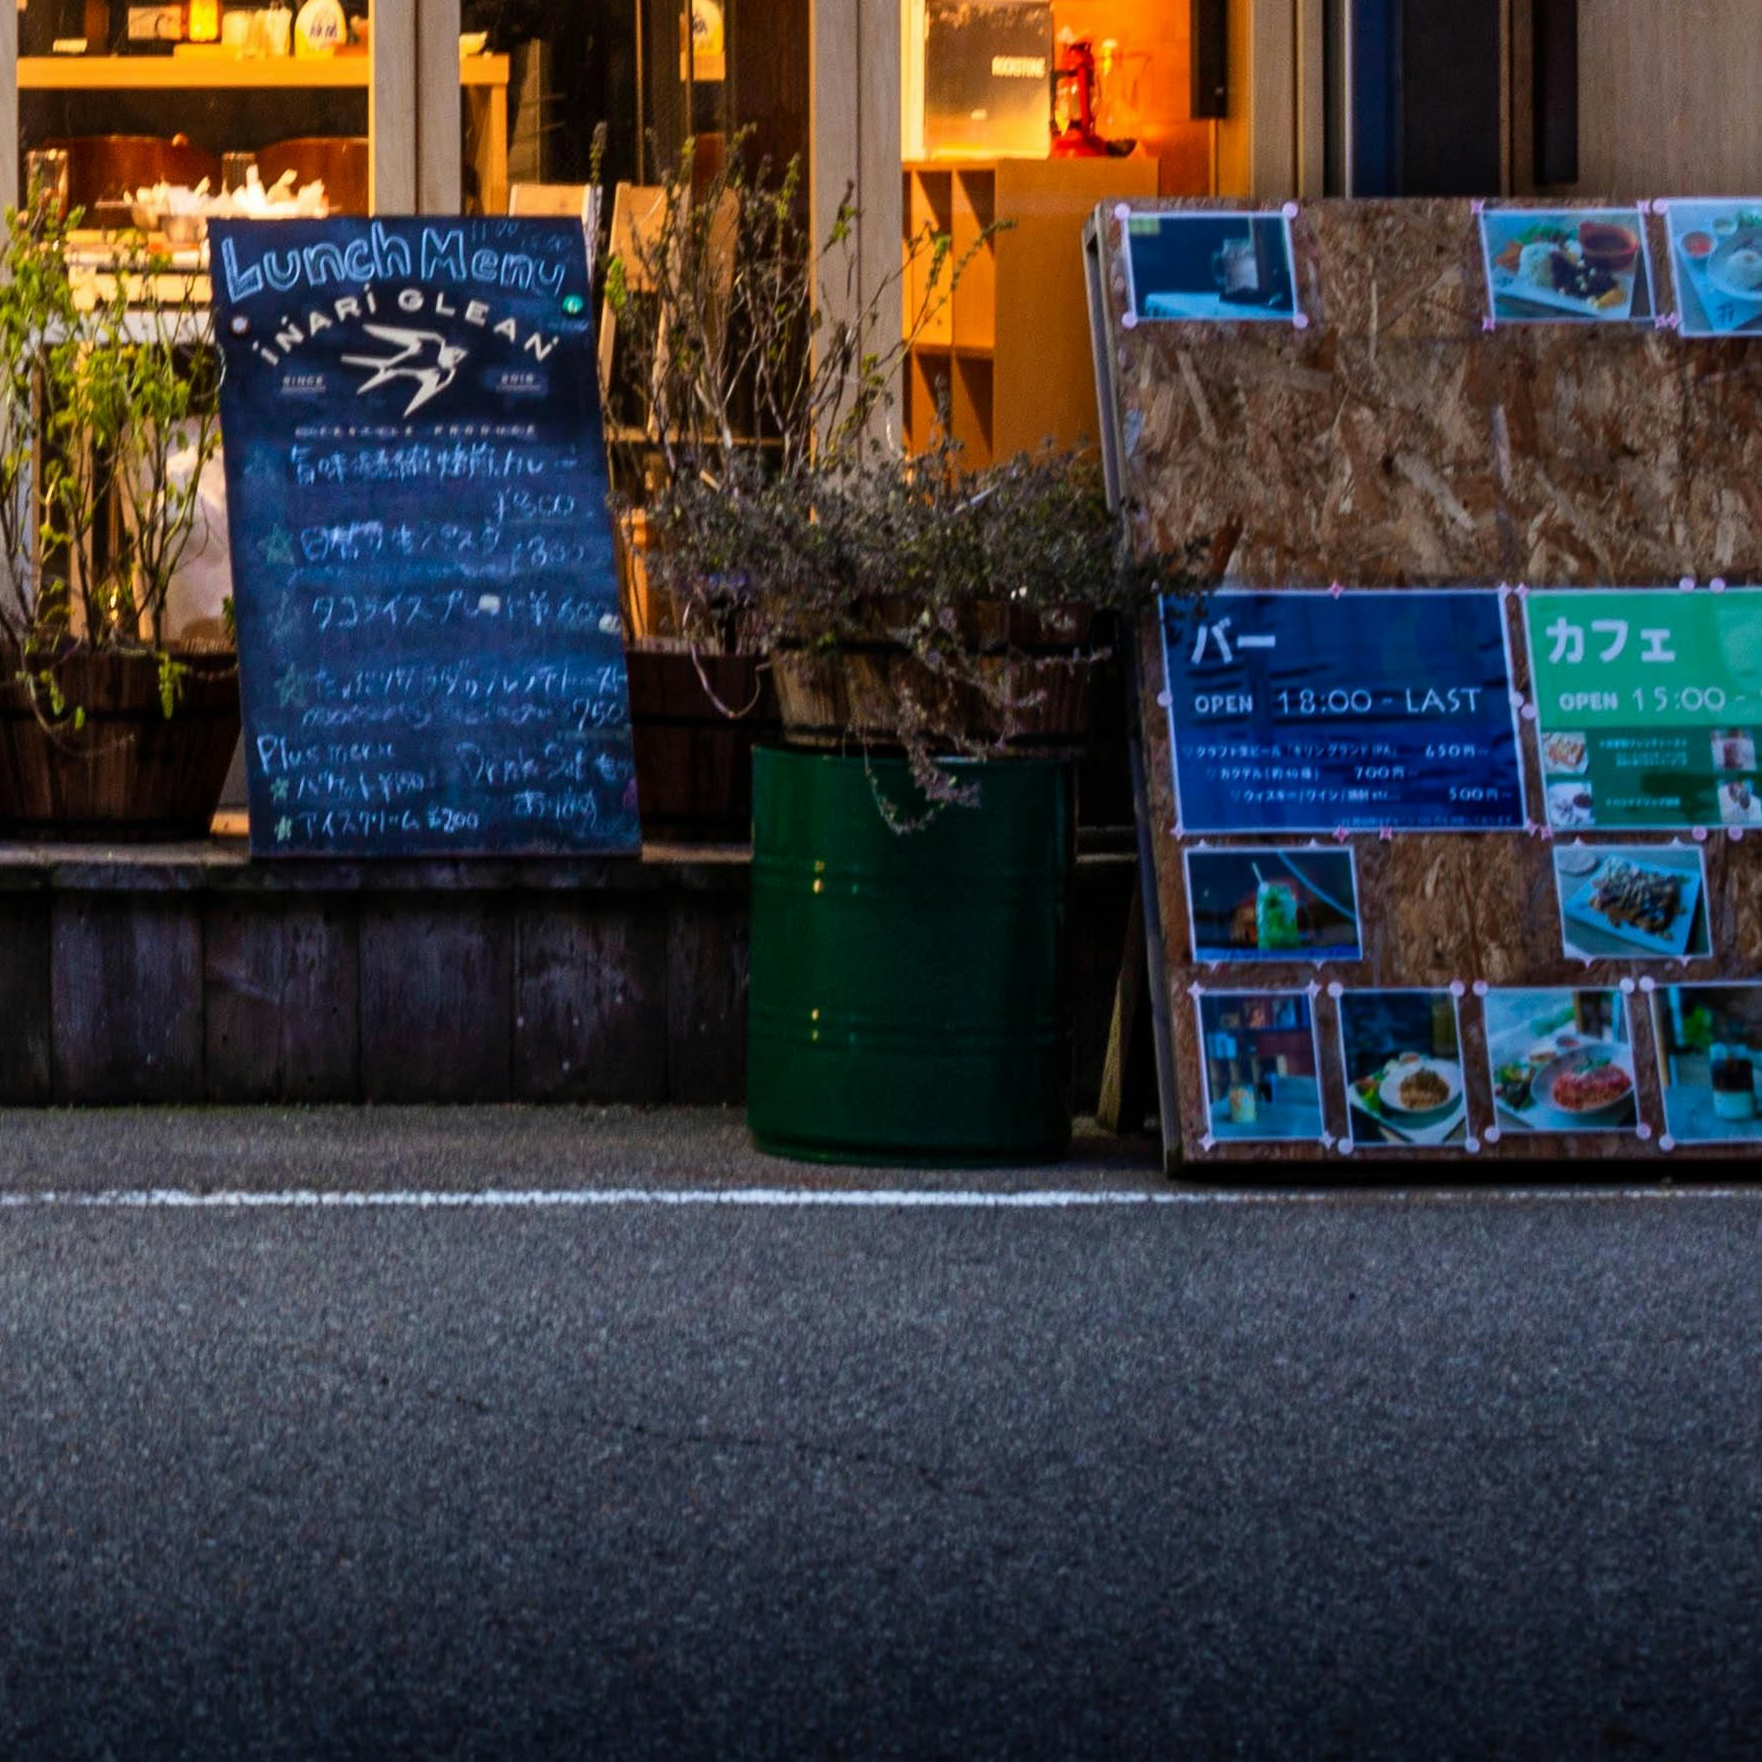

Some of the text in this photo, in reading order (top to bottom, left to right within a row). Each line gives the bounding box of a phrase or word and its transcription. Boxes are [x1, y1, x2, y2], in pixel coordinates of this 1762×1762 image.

[221, 222, 566, 304] Lunch Menu
[398, 288, 559, 362] GLEAN
[1190, 617, 1276, 665] バー
[1545, 616, 1676, 665] カフェ
[1194, 692, 1254, 714] OPEN
[1277, 687, 1373, 715] 18:00
[1405, 687, 1482, 714] LAST
[1558, 691, 1619, 712] OPEN
[1632, 686, 1726, 712] 15:00
